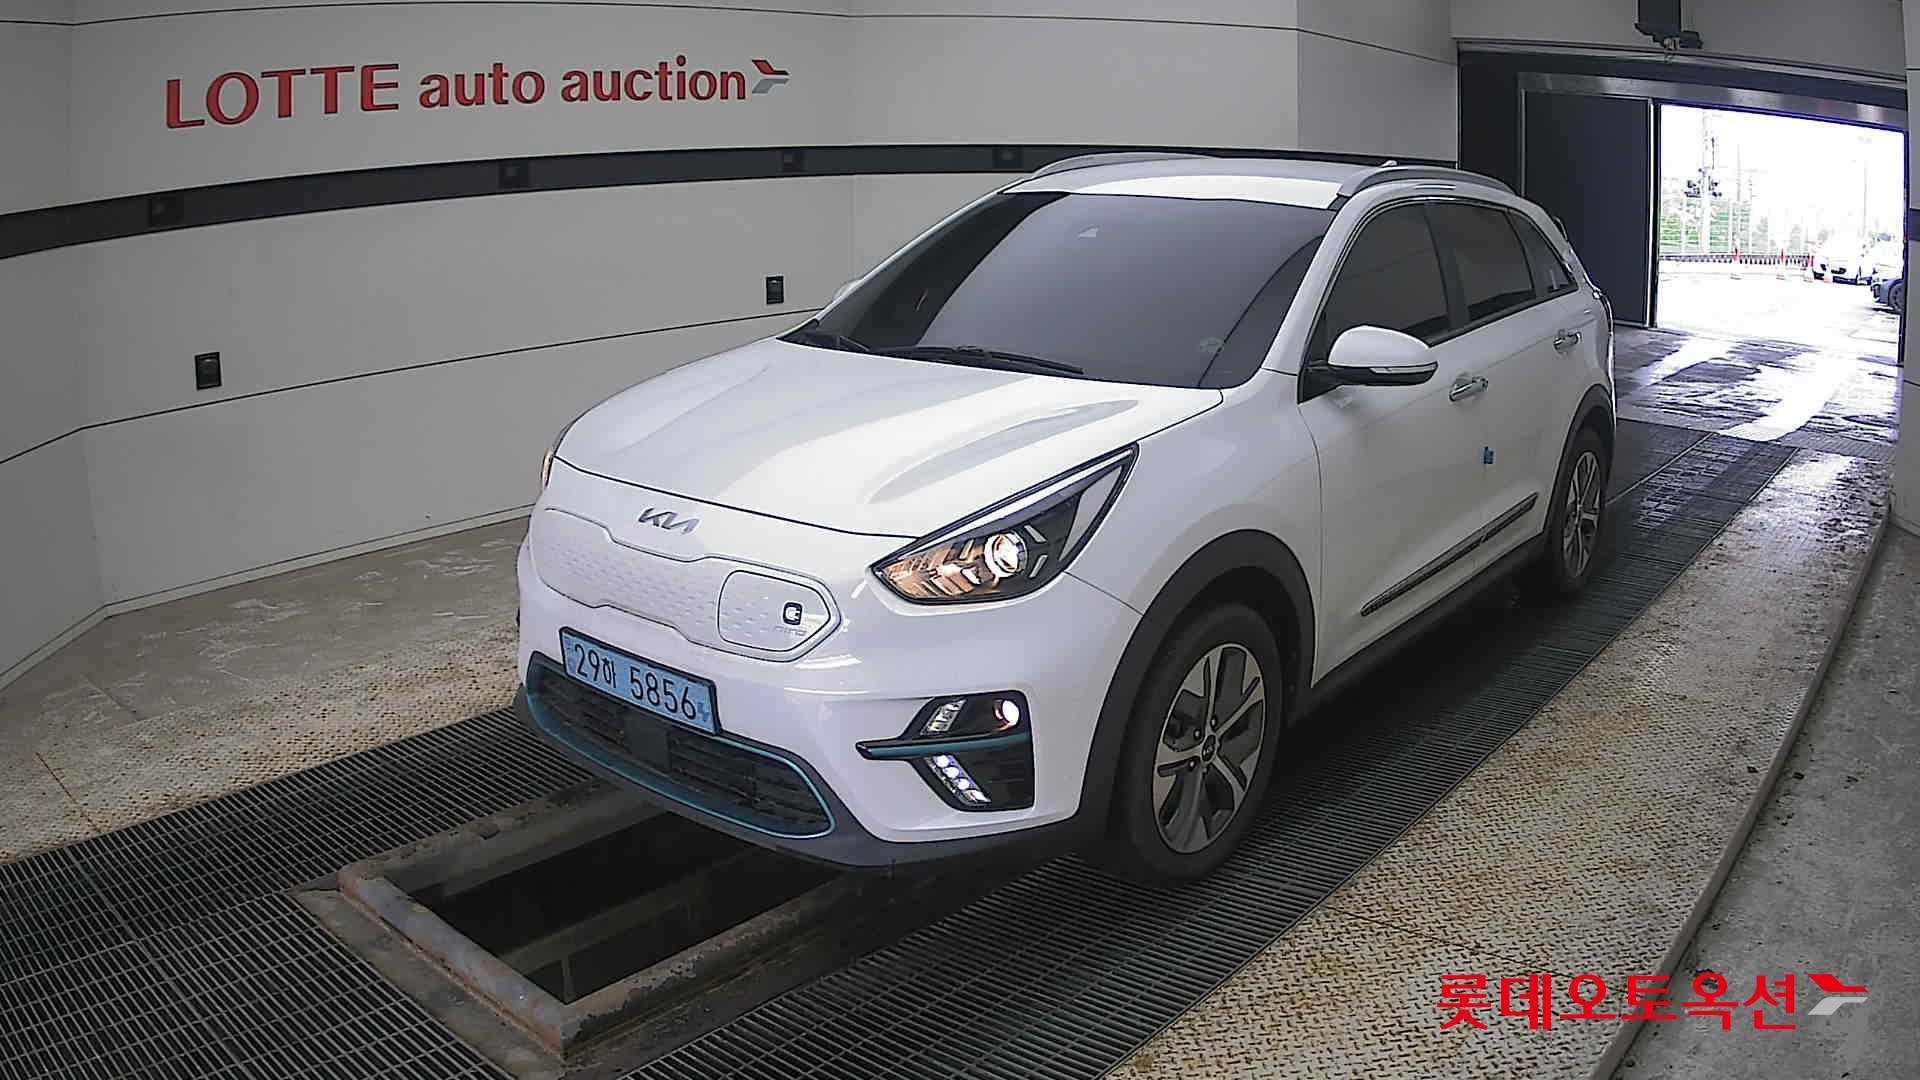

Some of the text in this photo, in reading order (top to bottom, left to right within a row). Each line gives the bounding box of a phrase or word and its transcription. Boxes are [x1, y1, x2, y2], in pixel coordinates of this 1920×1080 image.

[166, 55, 746, 129] LOTTE auto auction
[574, 643, 697, 720] 29하 5856
